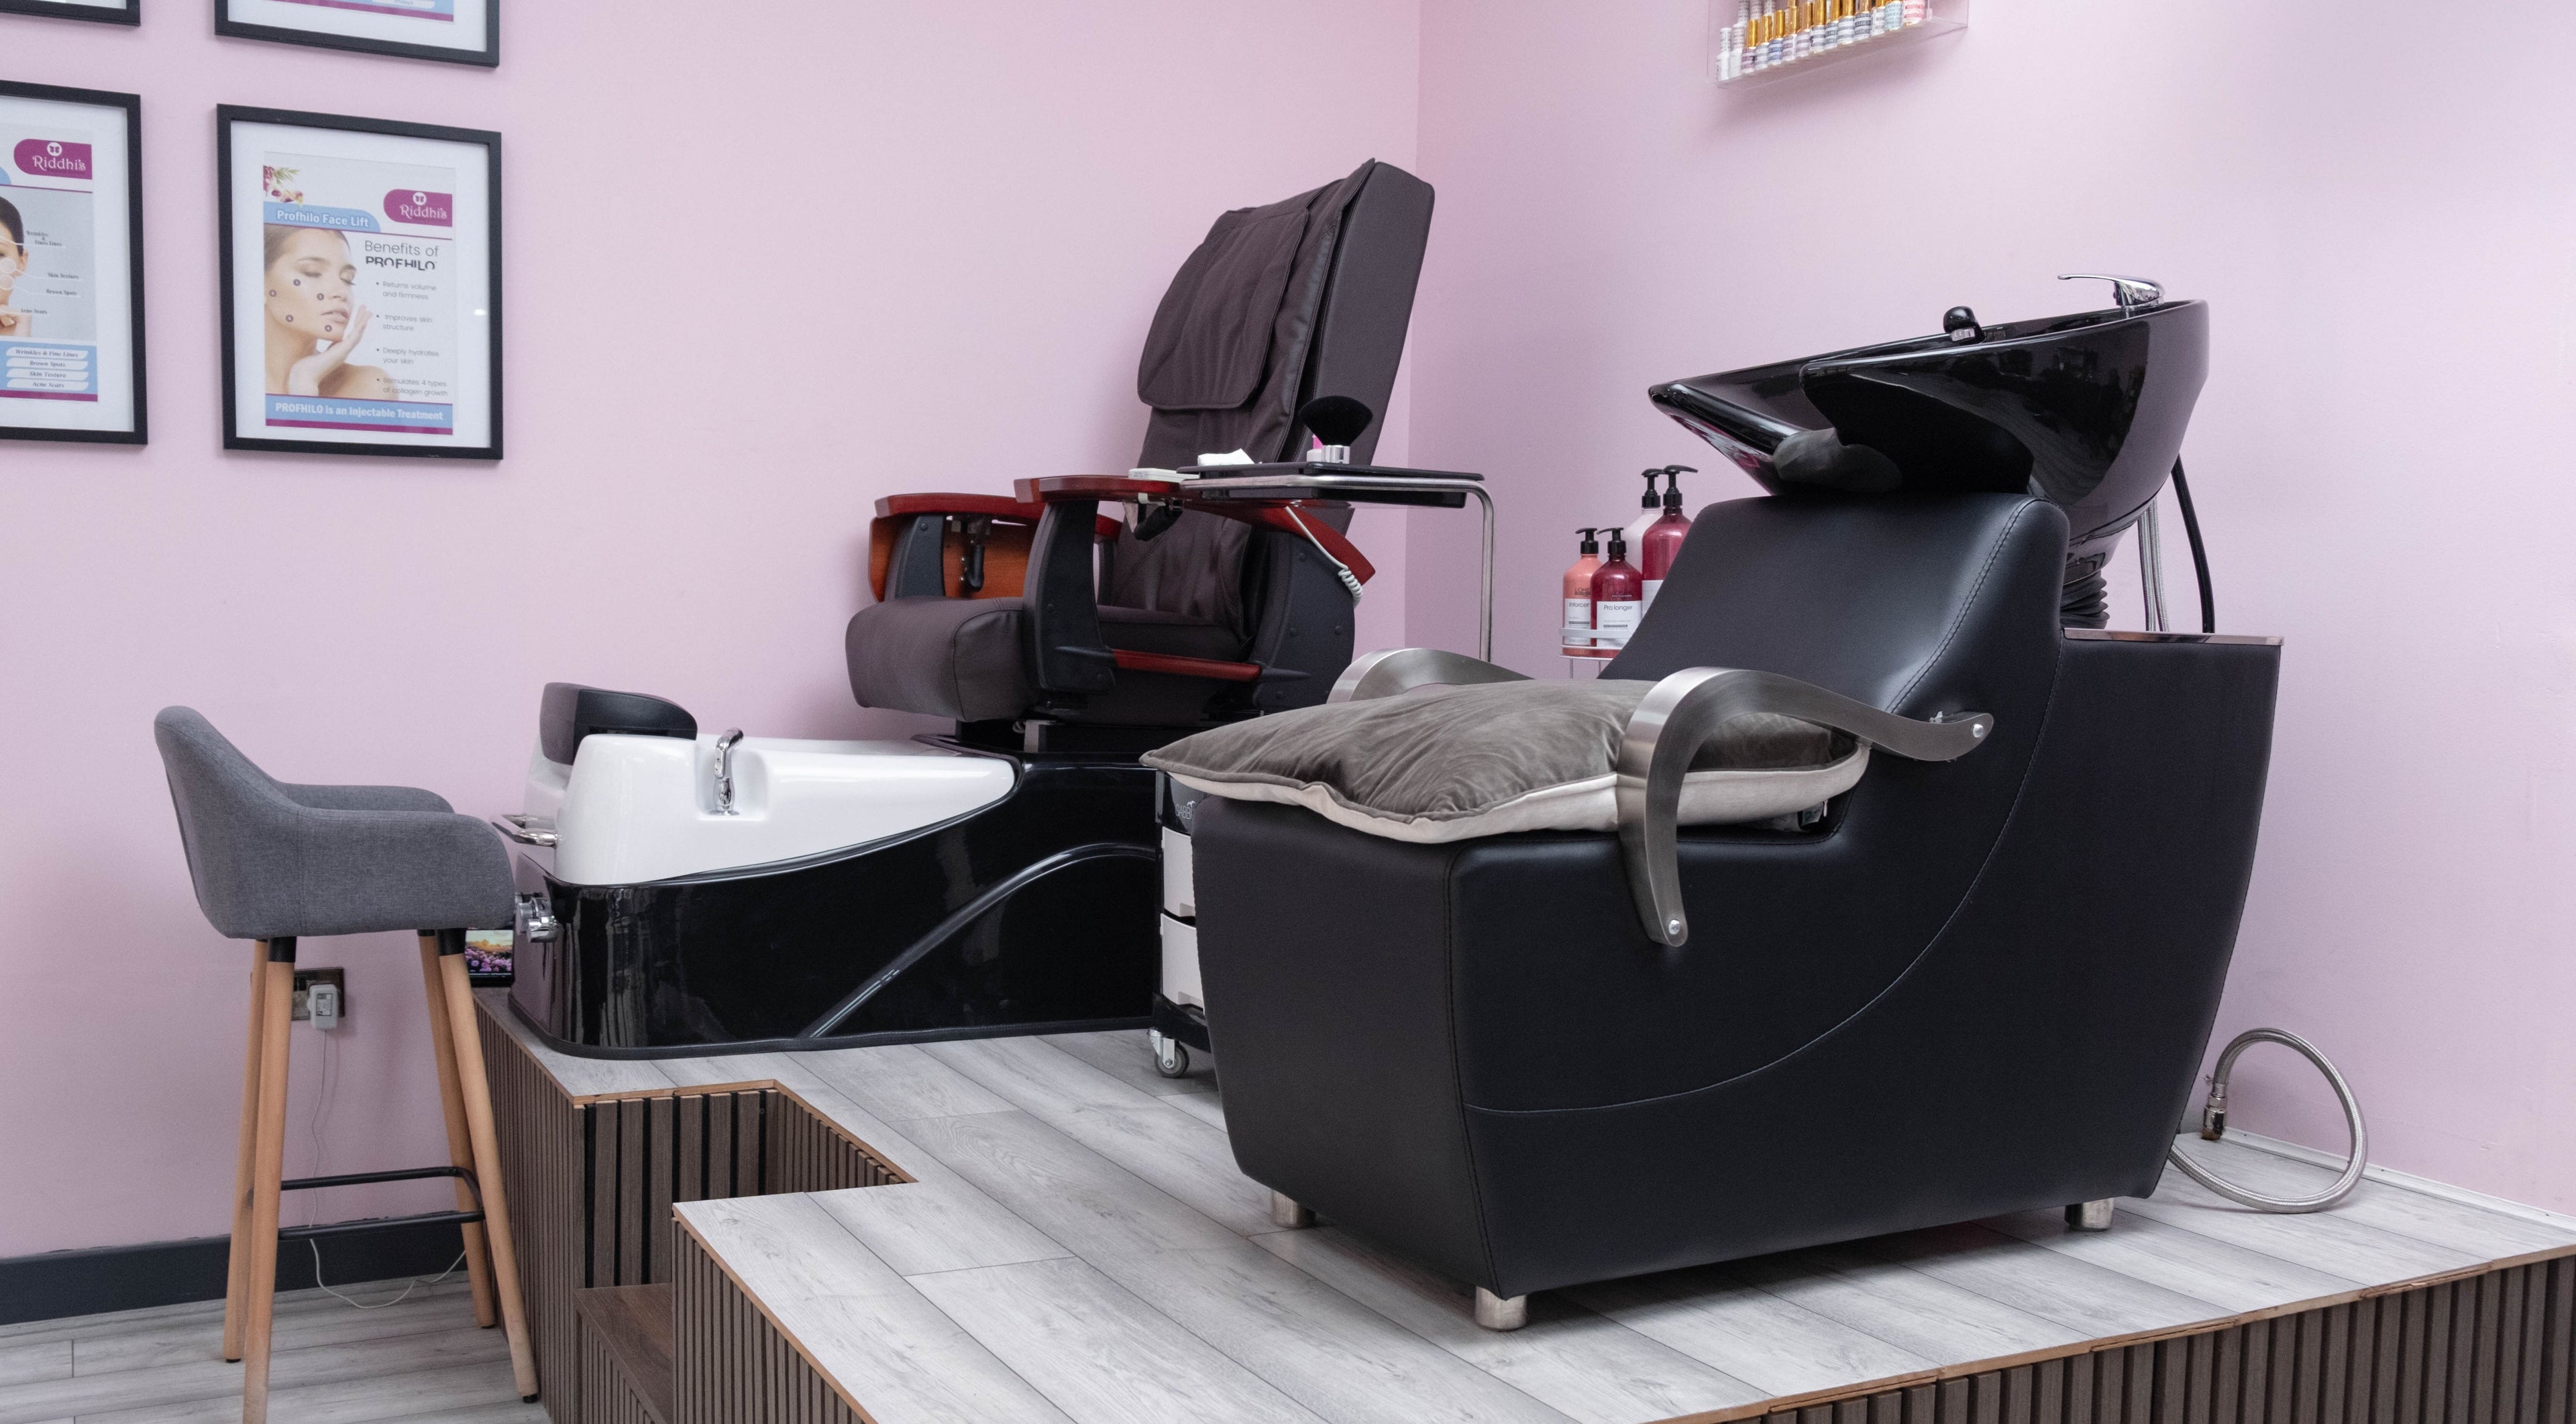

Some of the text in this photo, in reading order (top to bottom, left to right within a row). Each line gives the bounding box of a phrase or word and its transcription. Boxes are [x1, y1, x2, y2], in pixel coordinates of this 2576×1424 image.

[32, 155, 86, 171] Riddhi's
[399, 204, 447, 219] Riddhi's
[276, 210, 369, 227] Profhilo Face Lift
[365, 240, 439, 256] Benefits of
[398, 292, 428, 300] firmness
[384, 314, 417, 322] Improves
[382, 347, 439, 357] Deeply hydrates
[383, 377, 419, 386] Stimulates
[428, 380, 447, 388] types
[392, 388, 422, 396] collagen
[423, 389, 448, 397] growth
[276, 402, 443, 421] PROFHILO is an Injectable Treatment
